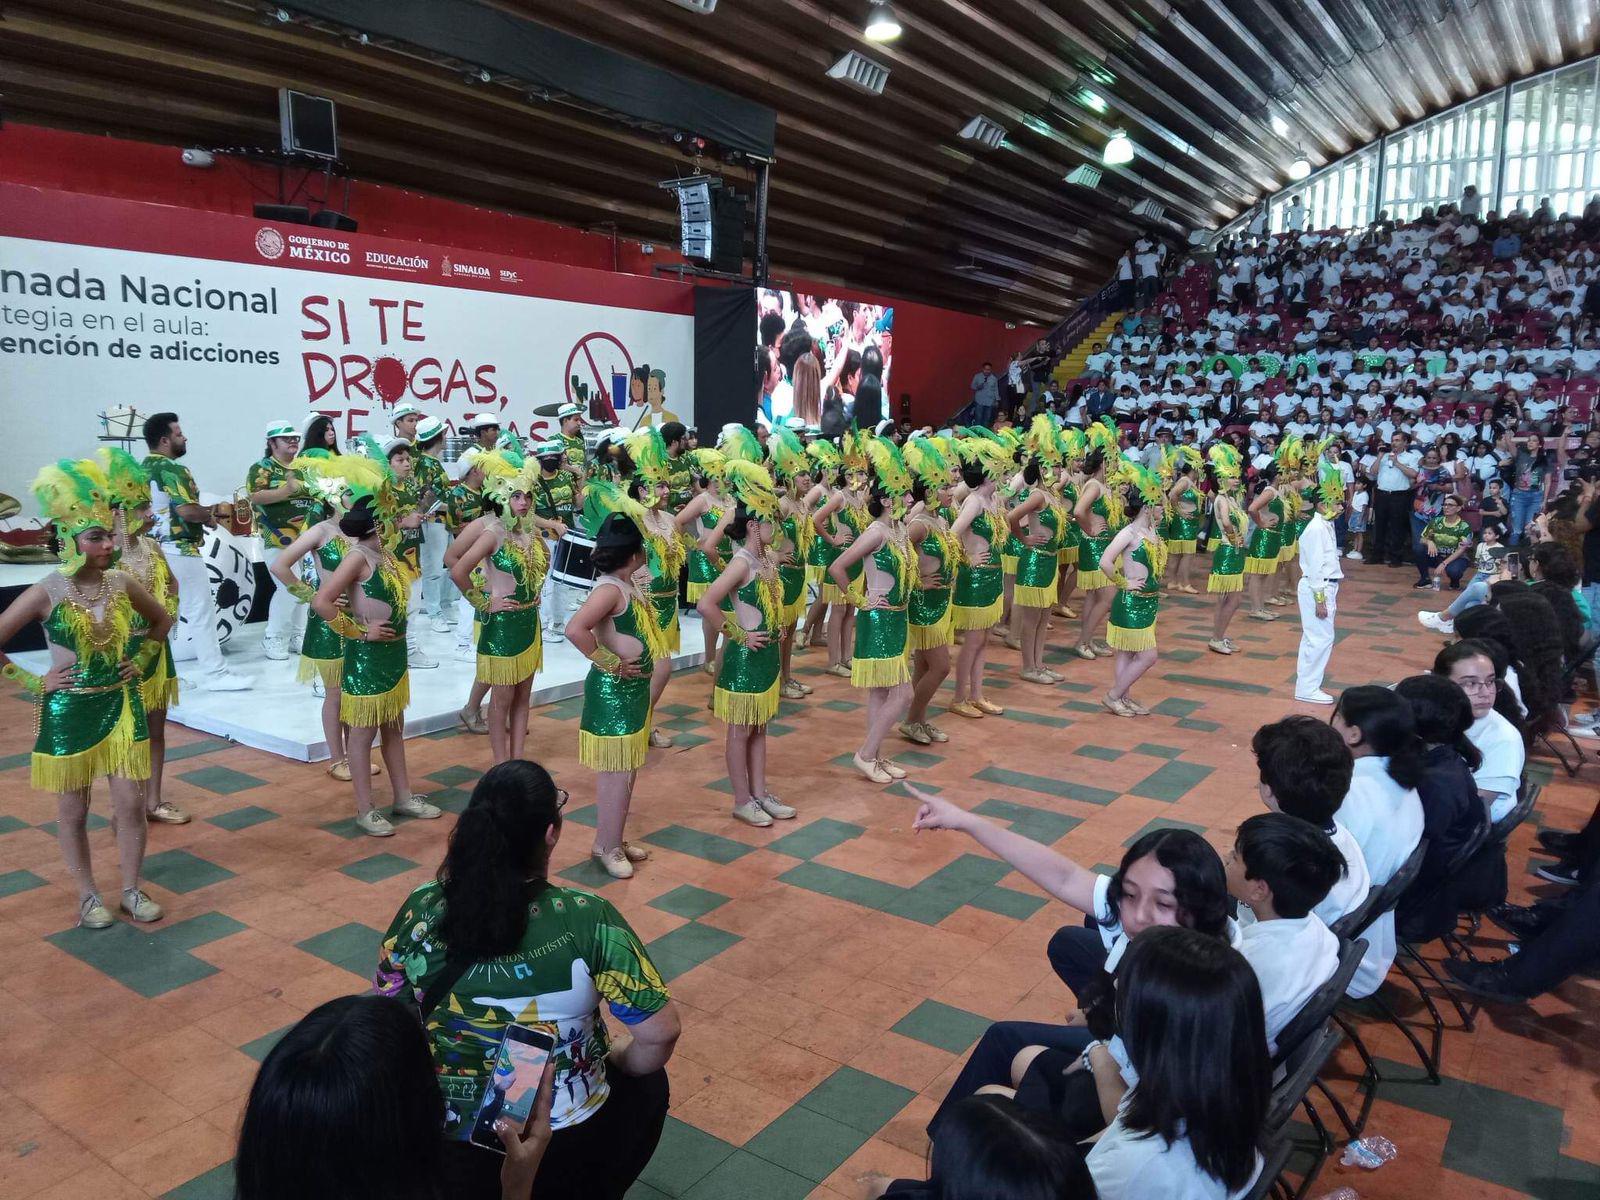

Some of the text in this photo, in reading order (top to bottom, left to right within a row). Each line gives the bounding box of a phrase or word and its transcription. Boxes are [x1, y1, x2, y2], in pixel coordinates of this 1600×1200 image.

[288, 235, 350, 250] GOBIERNO DE
[289, 246, 351, 264] MÉXICO
[365, 252, 429, 269] EDUCACIÓN
[453, 264, 490, 276] SINALOA
[1554, 275, 1564, 287] 15
[121, 274, 277, 315] Nacional
[82, 314, 115, 330] en
[124, 312, 144, 332] el
[153, 315, 209, 336] aula:
[301, 295, 426, 345] SI TE
[108, 338, 142, 359] de
[149, 340, 280, 365] adicciones
